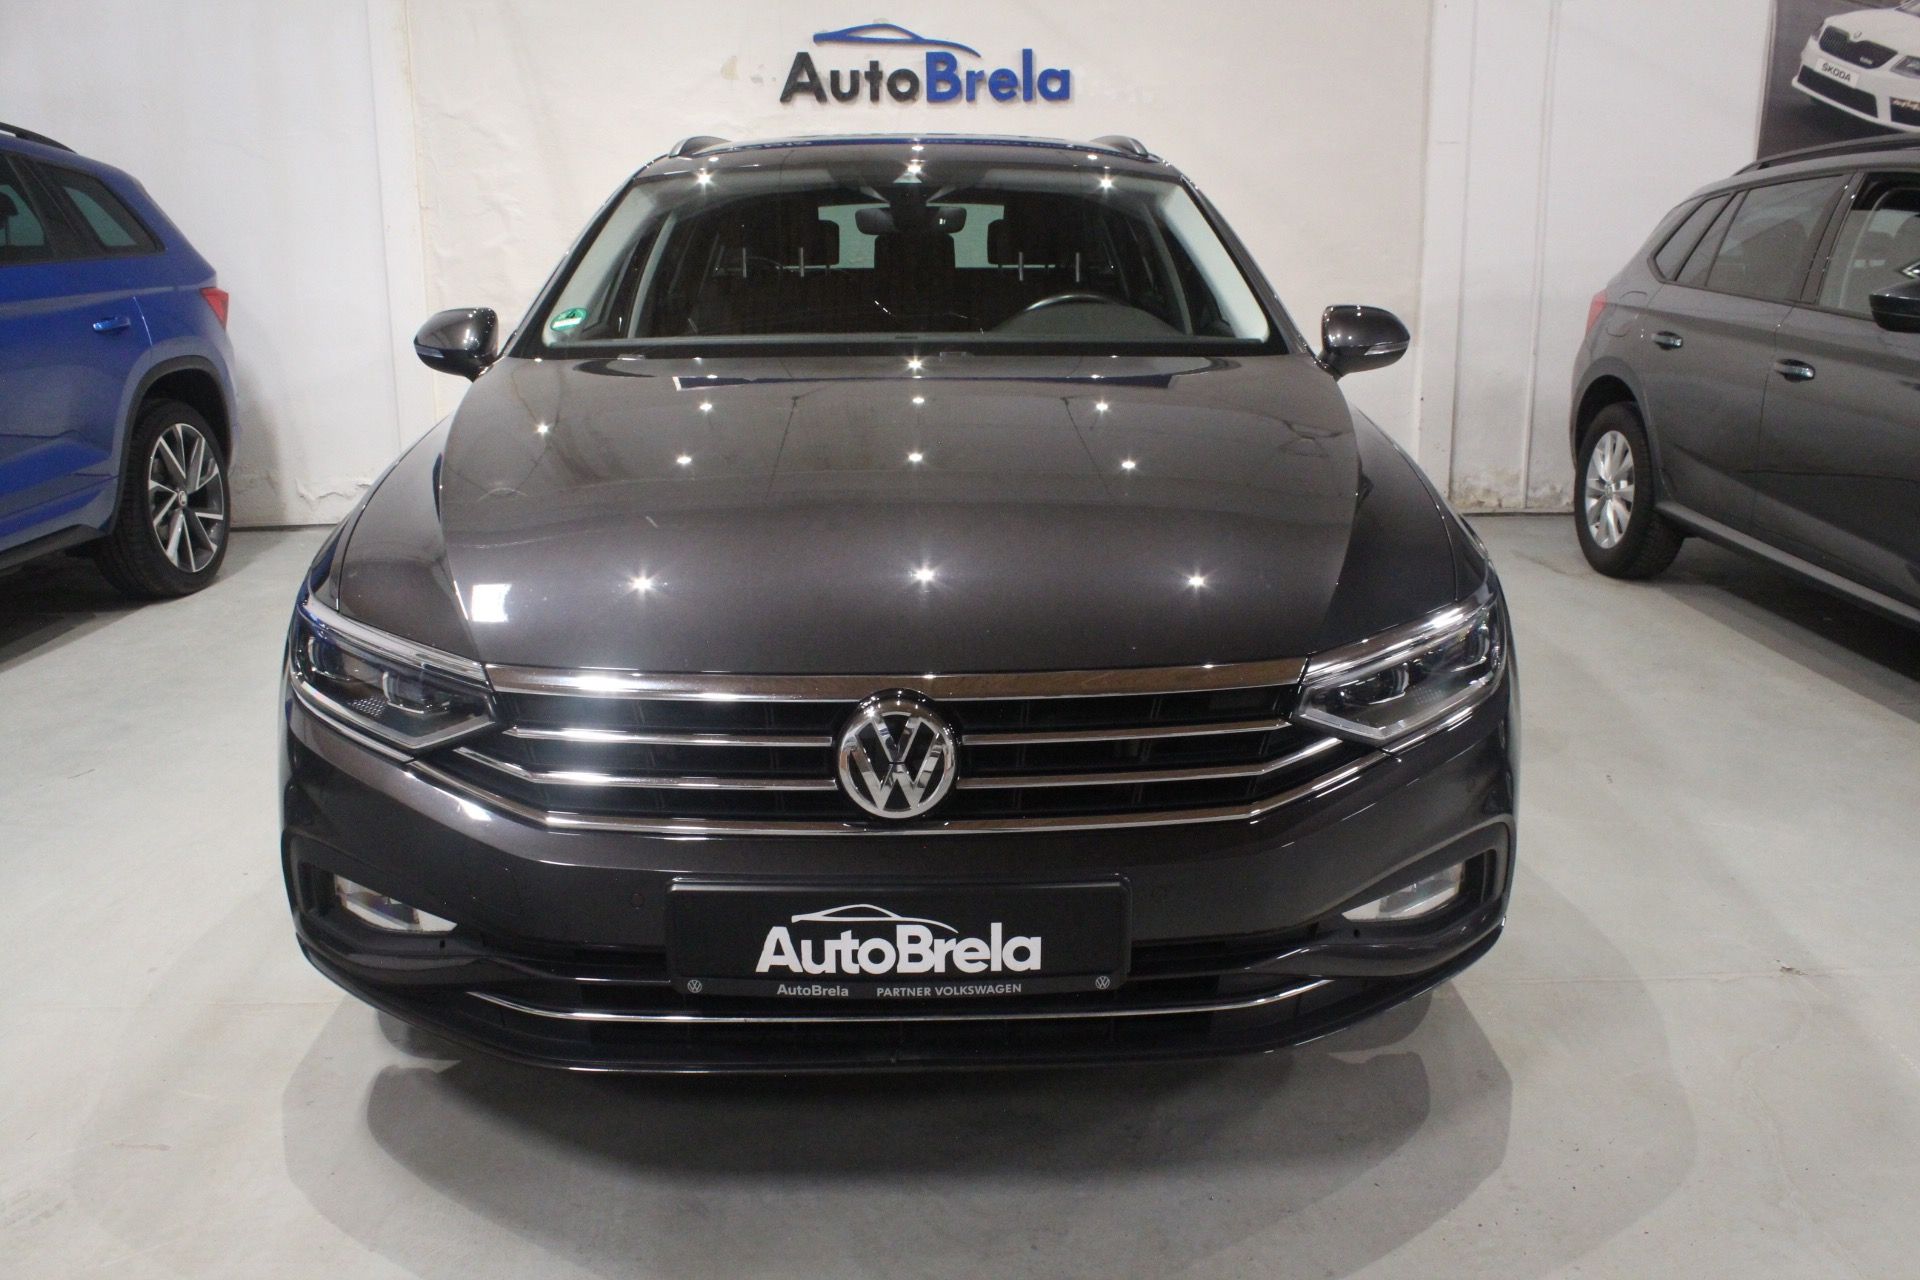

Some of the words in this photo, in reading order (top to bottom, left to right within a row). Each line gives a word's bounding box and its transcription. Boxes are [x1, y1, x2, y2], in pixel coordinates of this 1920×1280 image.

[779, 48, 1071, 104] AutoBrela
[755, 922, 1042, 974] AutoBrela
[776, 984, 849, 997] AutoBrela
[876, 987, 931, 997] PARTNER
[934, 984, 1022, 996] VOLKSWAGEN
